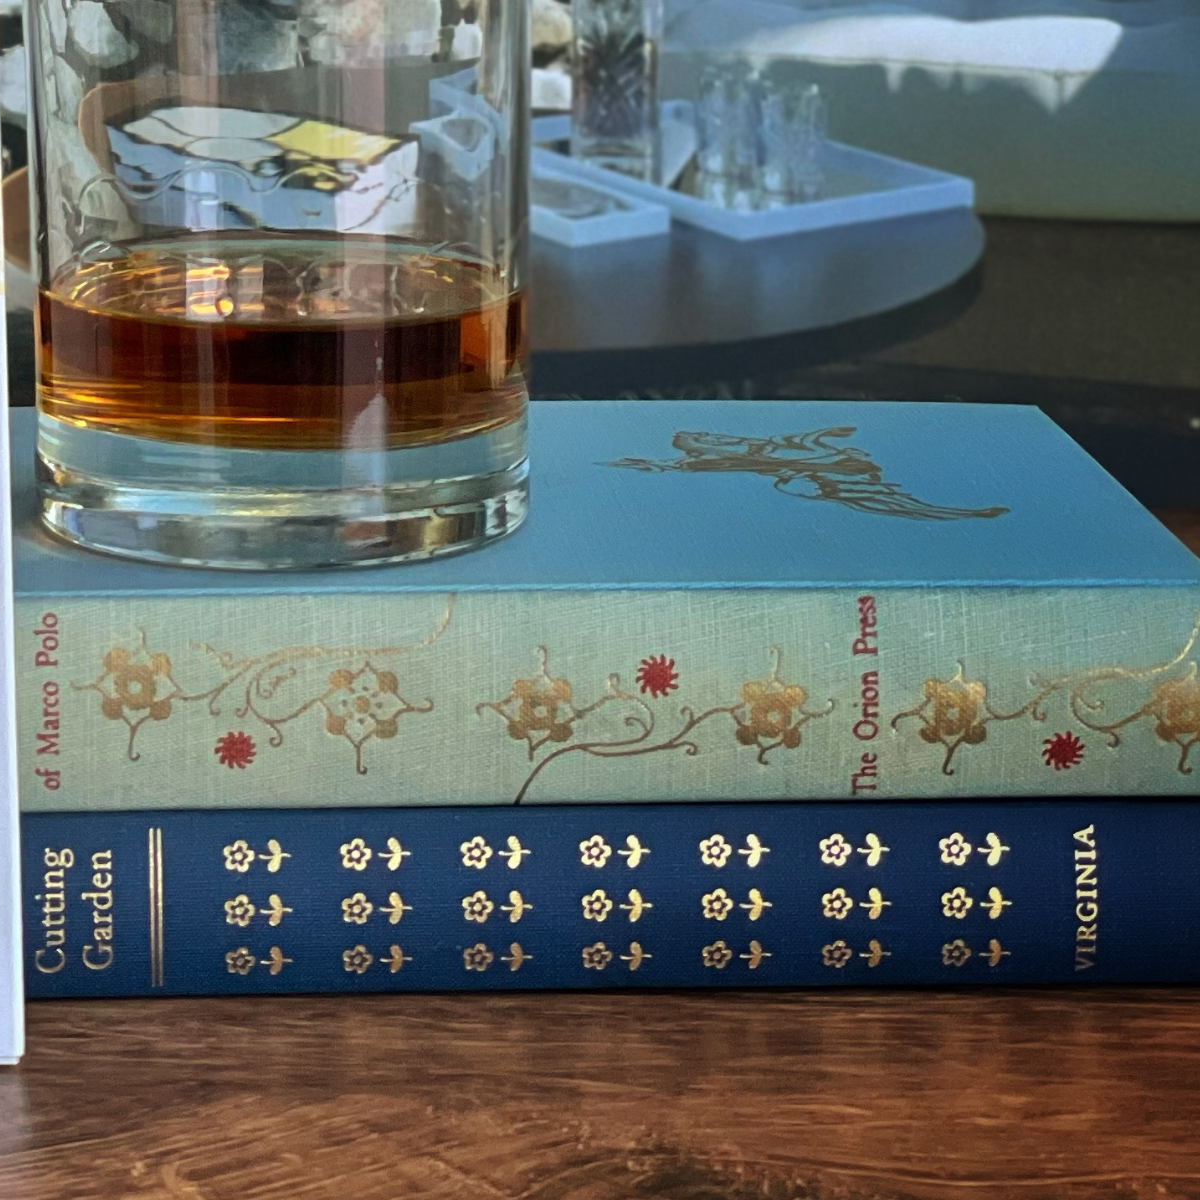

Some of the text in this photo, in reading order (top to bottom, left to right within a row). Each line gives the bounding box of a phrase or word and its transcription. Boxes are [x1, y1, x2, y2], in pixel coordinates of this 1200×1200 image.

[33, 611, 62, 791] of Marco Polo
[850, 594, 880, 796] The Orion Press
[34, 847, 75, 974] Cutting
[80, 849, 113, 970] Garden
[1072, 824, 1099, 973] VIRGINIA
